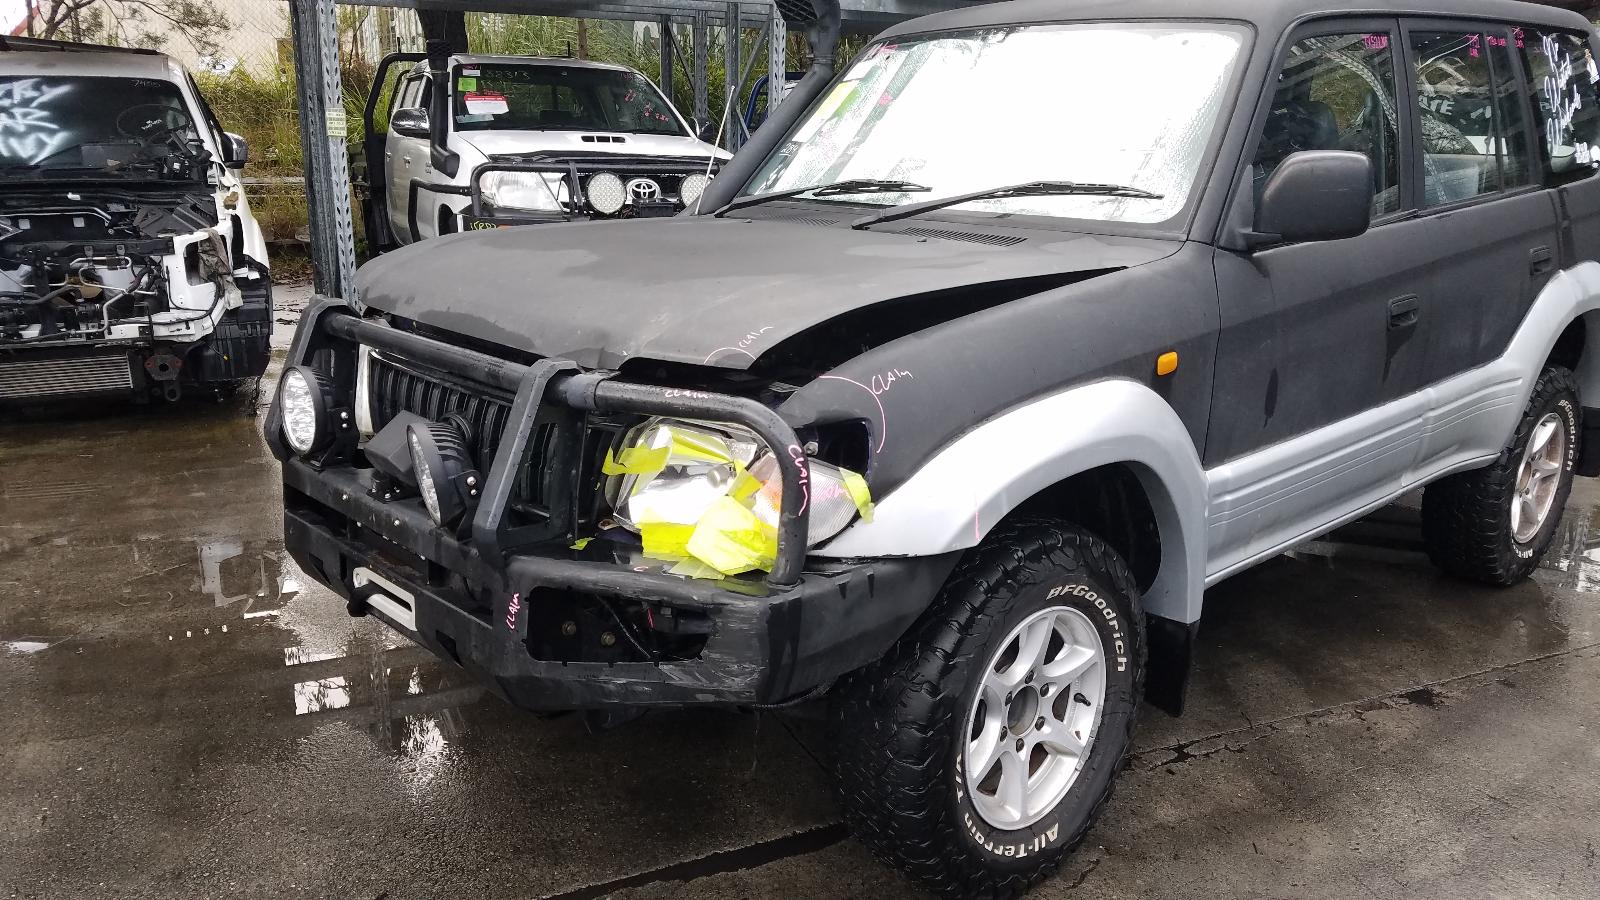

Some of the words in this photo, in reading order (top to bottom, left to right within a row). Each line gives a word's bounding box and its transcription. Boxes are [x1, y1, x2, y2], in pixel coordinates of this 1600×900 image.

[1558, 399, 1577, 472] BFGoodrich
[1045, 584, 1128, 672] BFGoodrich
[964, 812, 1059, 859] All-Terrain
